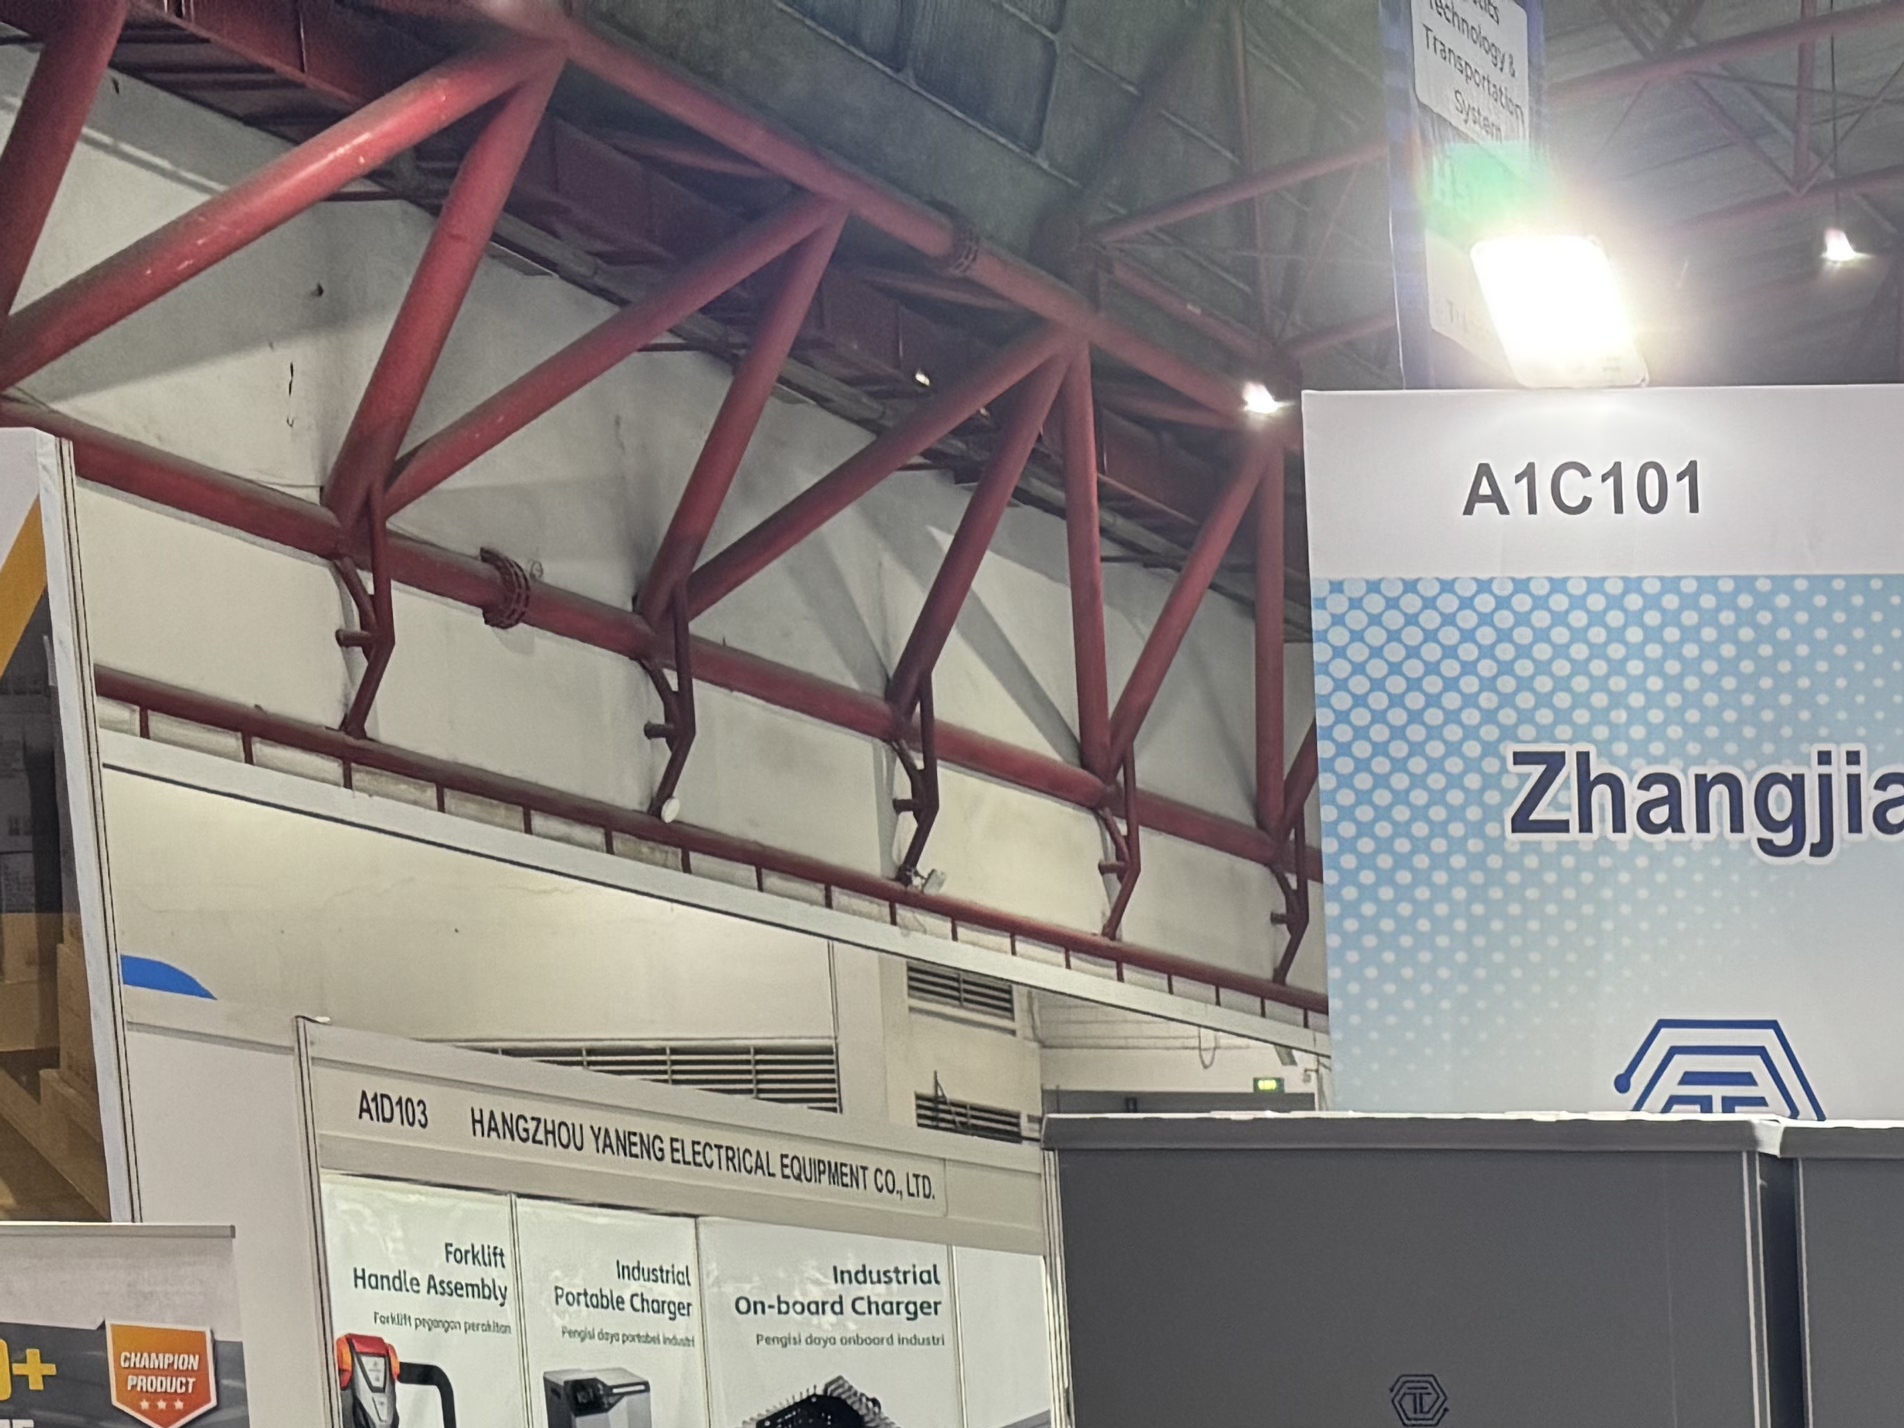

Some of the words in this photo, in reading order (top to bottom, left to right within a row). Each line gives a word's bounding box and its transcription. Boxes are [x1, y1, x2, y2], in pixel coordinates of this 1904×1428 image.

[1422, 22, 1525, 126] Transportation
[1454, 89, 1503, 144] System
[1462, 460, 1704, 518] A1C101
[358, 1089, 428, 1129] A1D103
[470, 1106, 585, 1151] HANGZHOU
[589, 1124, 665, 1162] YANENG
[669, 1137, 776, 1178] ELECTRICAL
[780, 1153, 869, 1192] EQUIPMENT
[874, 1168, 904, 1200] CO.,
[906, 1173, 936, 1200] LTD.
[444, 1242, 507, 1269] Forklift
[353, 1267, 421, 1295] Handle
[426, 1274, 508, 1307] Assembly
[616, 1259, 692, 1287] Industrial
[832, 1263, 941, 1286] Industrial
[554, 1285, 626, 1312] Portable
[629, 1292, 693, 1321] Charger
[734, 1294, 845, 1316] On-board
[850, 1295, 942, 1321] Charger
[755, 1333, 802, 1348] Pengisi
[805, 1334, 837, 1348] daya
[120, 1351, 200, 1372] CHAMPION
[127, 1375, 197, 1395] PRODUCT
